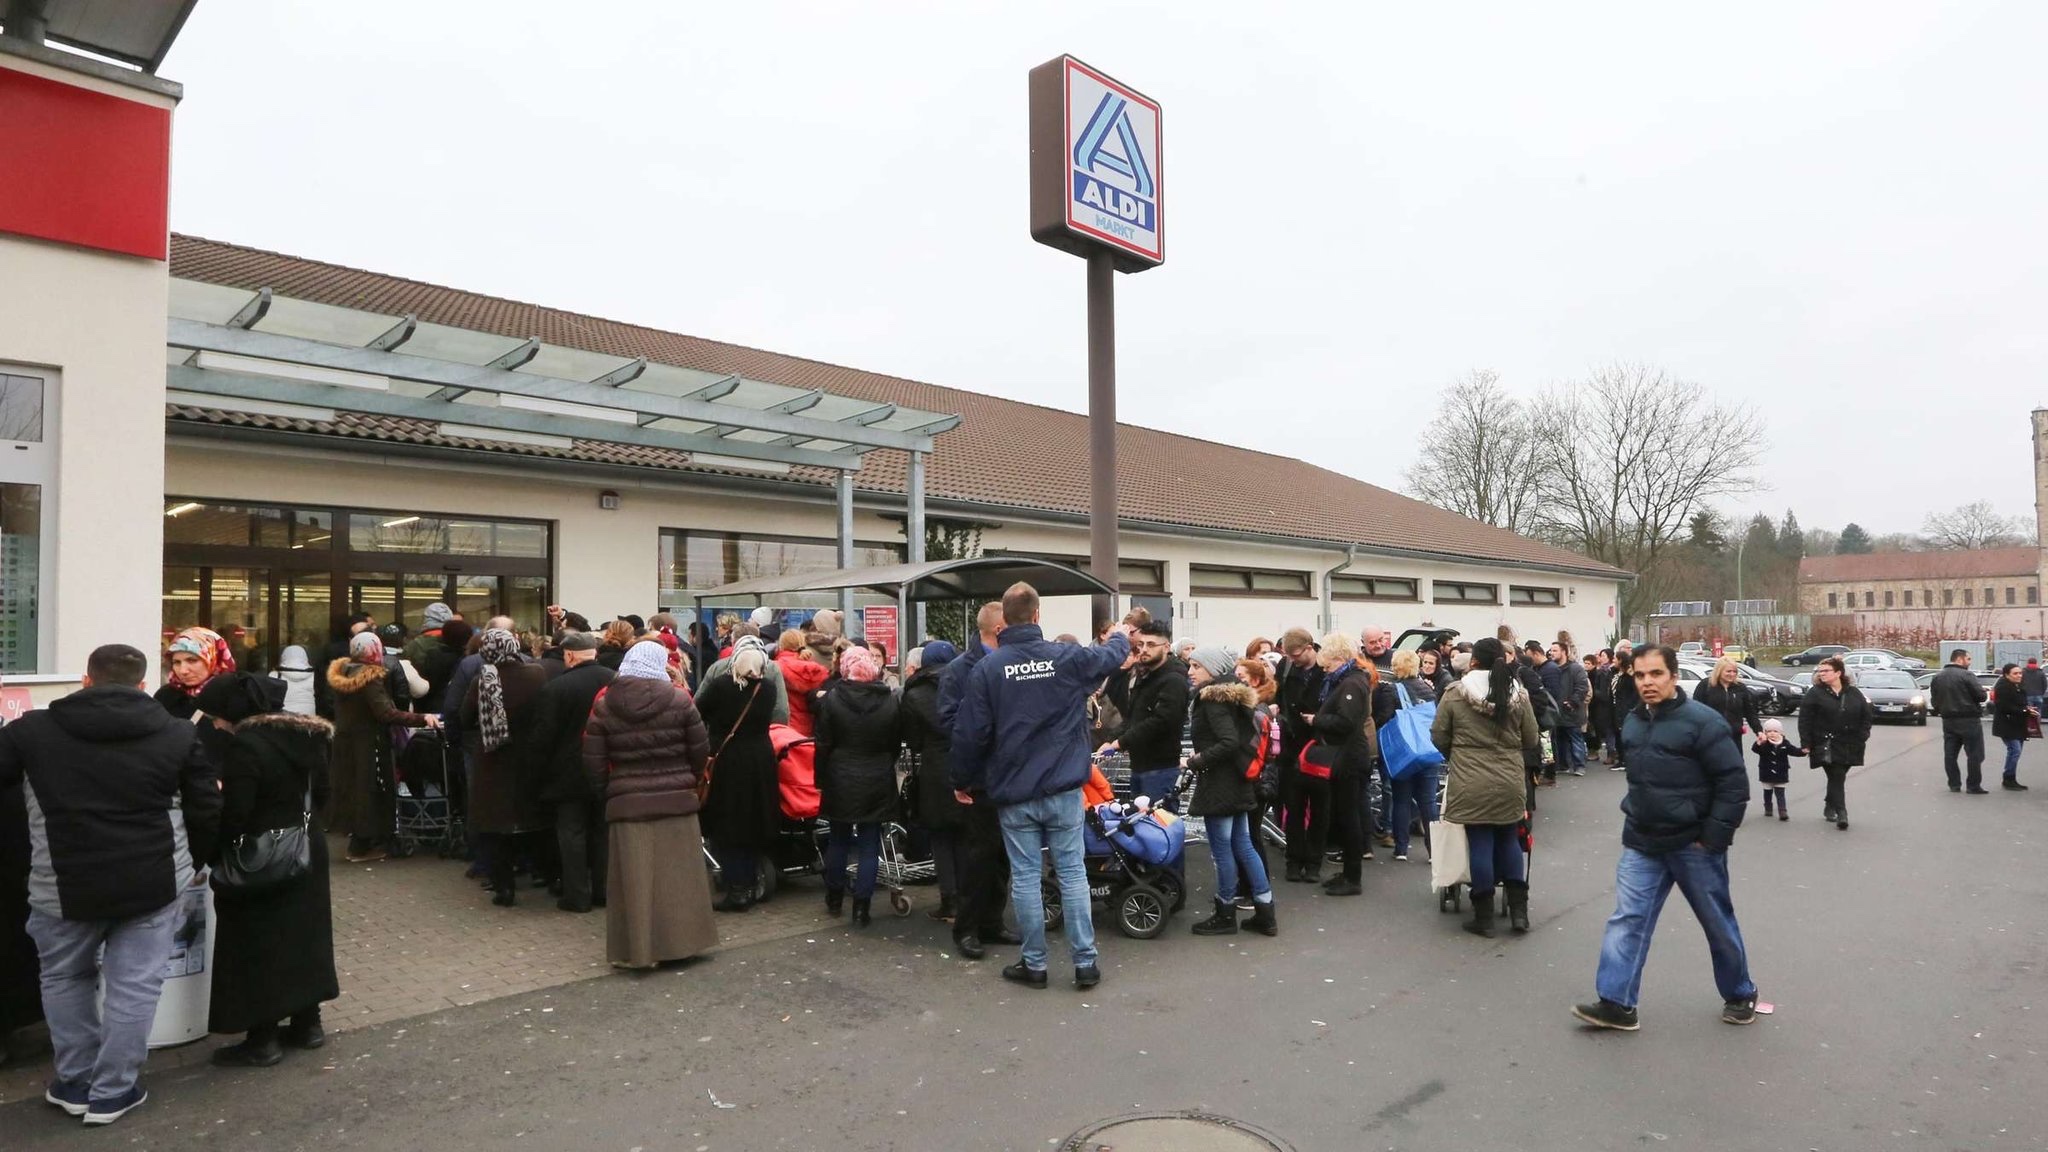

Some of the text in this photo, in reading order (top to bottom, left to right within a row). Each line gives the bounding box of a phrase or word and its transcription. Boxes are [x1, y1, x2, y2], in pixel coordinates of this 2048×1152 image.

[1081, 179, 1146, 227] ALDI
[1095, 214, 1135, 240] MARKT
[1004, 660, 1054, 679] protex
[1015, 671, 1056, 681] SICHERHEIT
